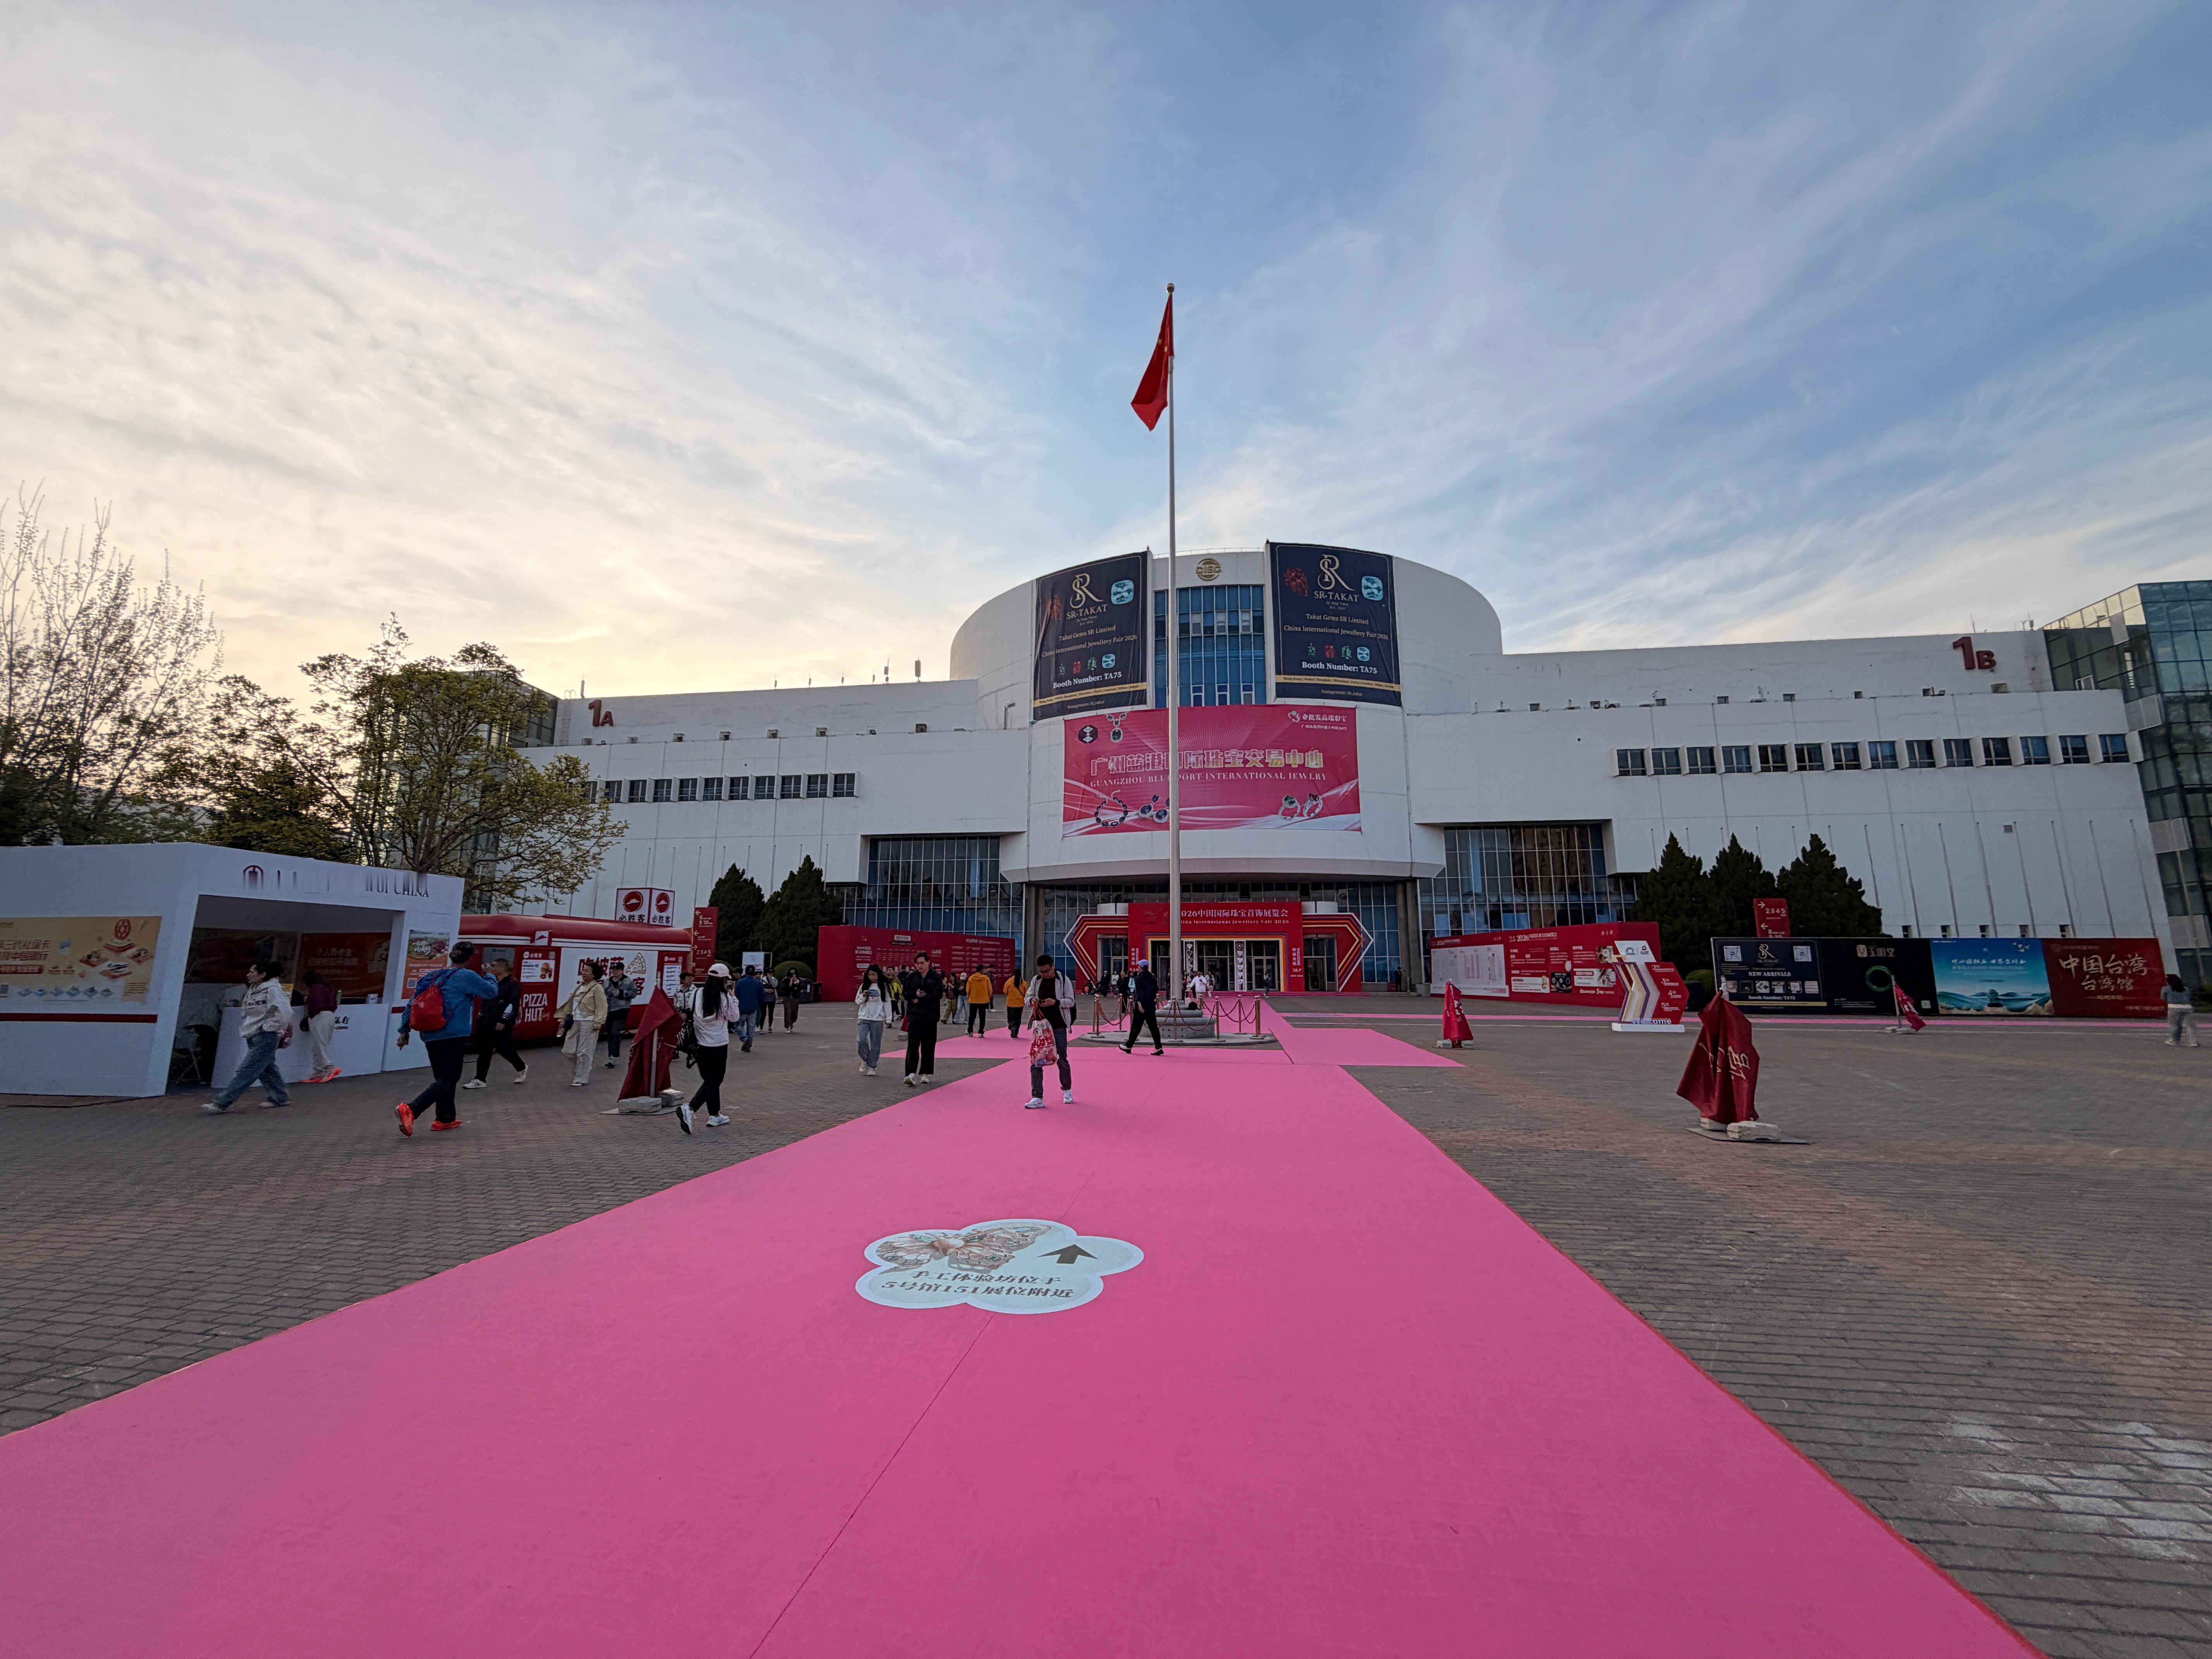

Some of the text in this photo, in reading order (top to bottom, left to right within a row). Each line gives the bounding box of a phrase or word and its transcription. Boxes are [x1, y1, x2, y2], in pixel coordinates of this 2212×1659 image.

[1314, 591, 1359, 602] SR-TAKAT
[1066, 604, 1108, 620] SR-TAKAT
[1096, 625, 1116, 634] Limited
[1341, 628, 1365, 638] Jewellery
[1056, 642, 1087, 654] International
[1087, 637, 1112, 648] Jewellery
[1953, 636, 1996, 670] 1B
[1302, 661, 1377, 674] Booth Number: TA75
[1053, 671, 1122, 689] Booth Number: TA75
[589, 699, 614, 726] 1A
[1090, 776, 1144, 787] GUANGZHOU
[619, 914, 645, 923] 必胜客
[652, 914, 671, 924] 必胜客
[1181, 909, 1288, 917] 026中国国际珠宝首饰展览会
[2059, 953, 2147, 979] 中国台湾
[2081, 975, 2134, 991] 台湾馆
[523, 993, 548, 1007] PIZZA
[524, 1007, 544, 1022] HUT
[881, 1281, 1074, 1298] 5号馆151展位附近
